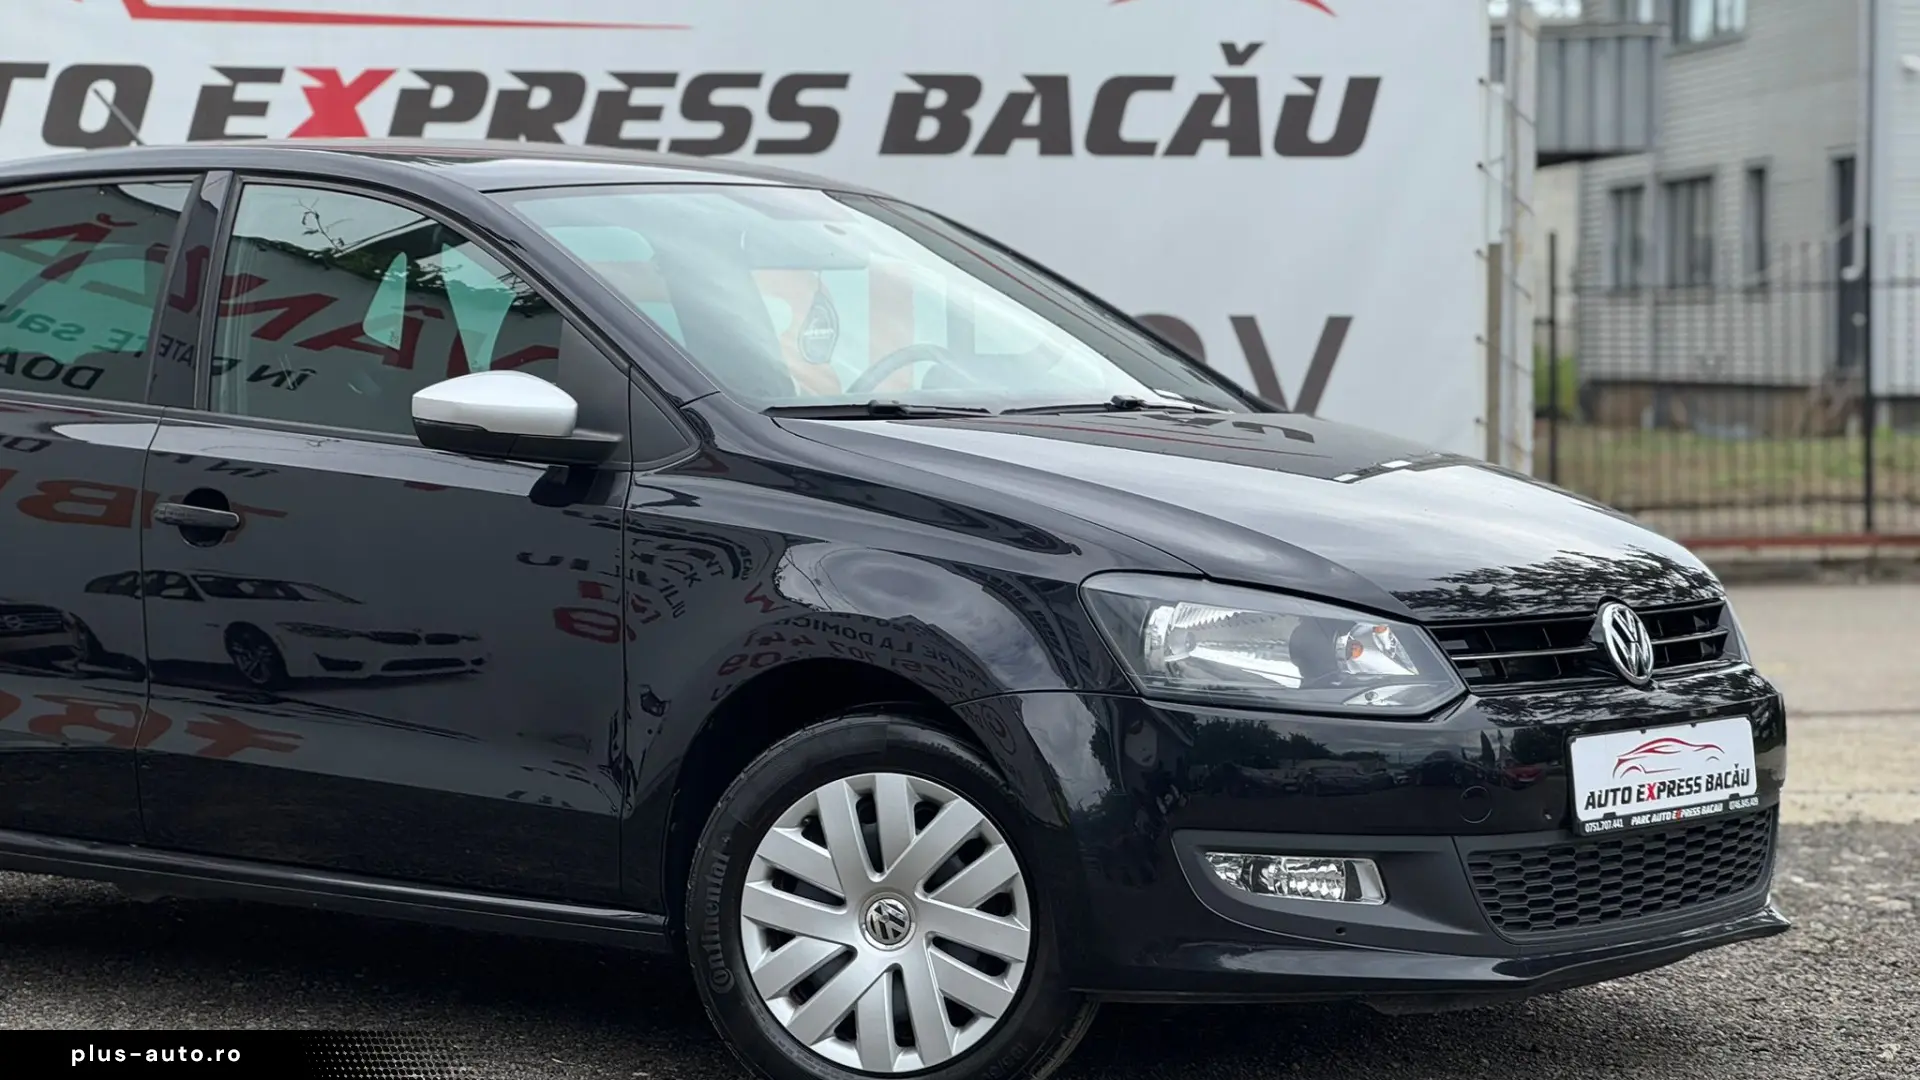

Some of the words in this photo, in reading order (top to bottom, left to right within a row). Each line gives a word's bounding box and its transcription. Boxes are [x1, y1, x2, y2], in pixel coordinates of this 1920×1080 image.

[187, 66, 851, 157] EXPRESS
[878, 41, 1382, 158] BACĂU
[1584, 786, 1632, 811] AUTO
[1636, 776, 1702, 803] EXPRESS
[1705, 763, 1750, 792] BACĂU
[1631, 813, 1651, 827] PARC
[1651, 810, 1672, 823] AUTO
[1672, 806, 1701, 820] EXPRESS
[701, 848, 735, 995] Continental
